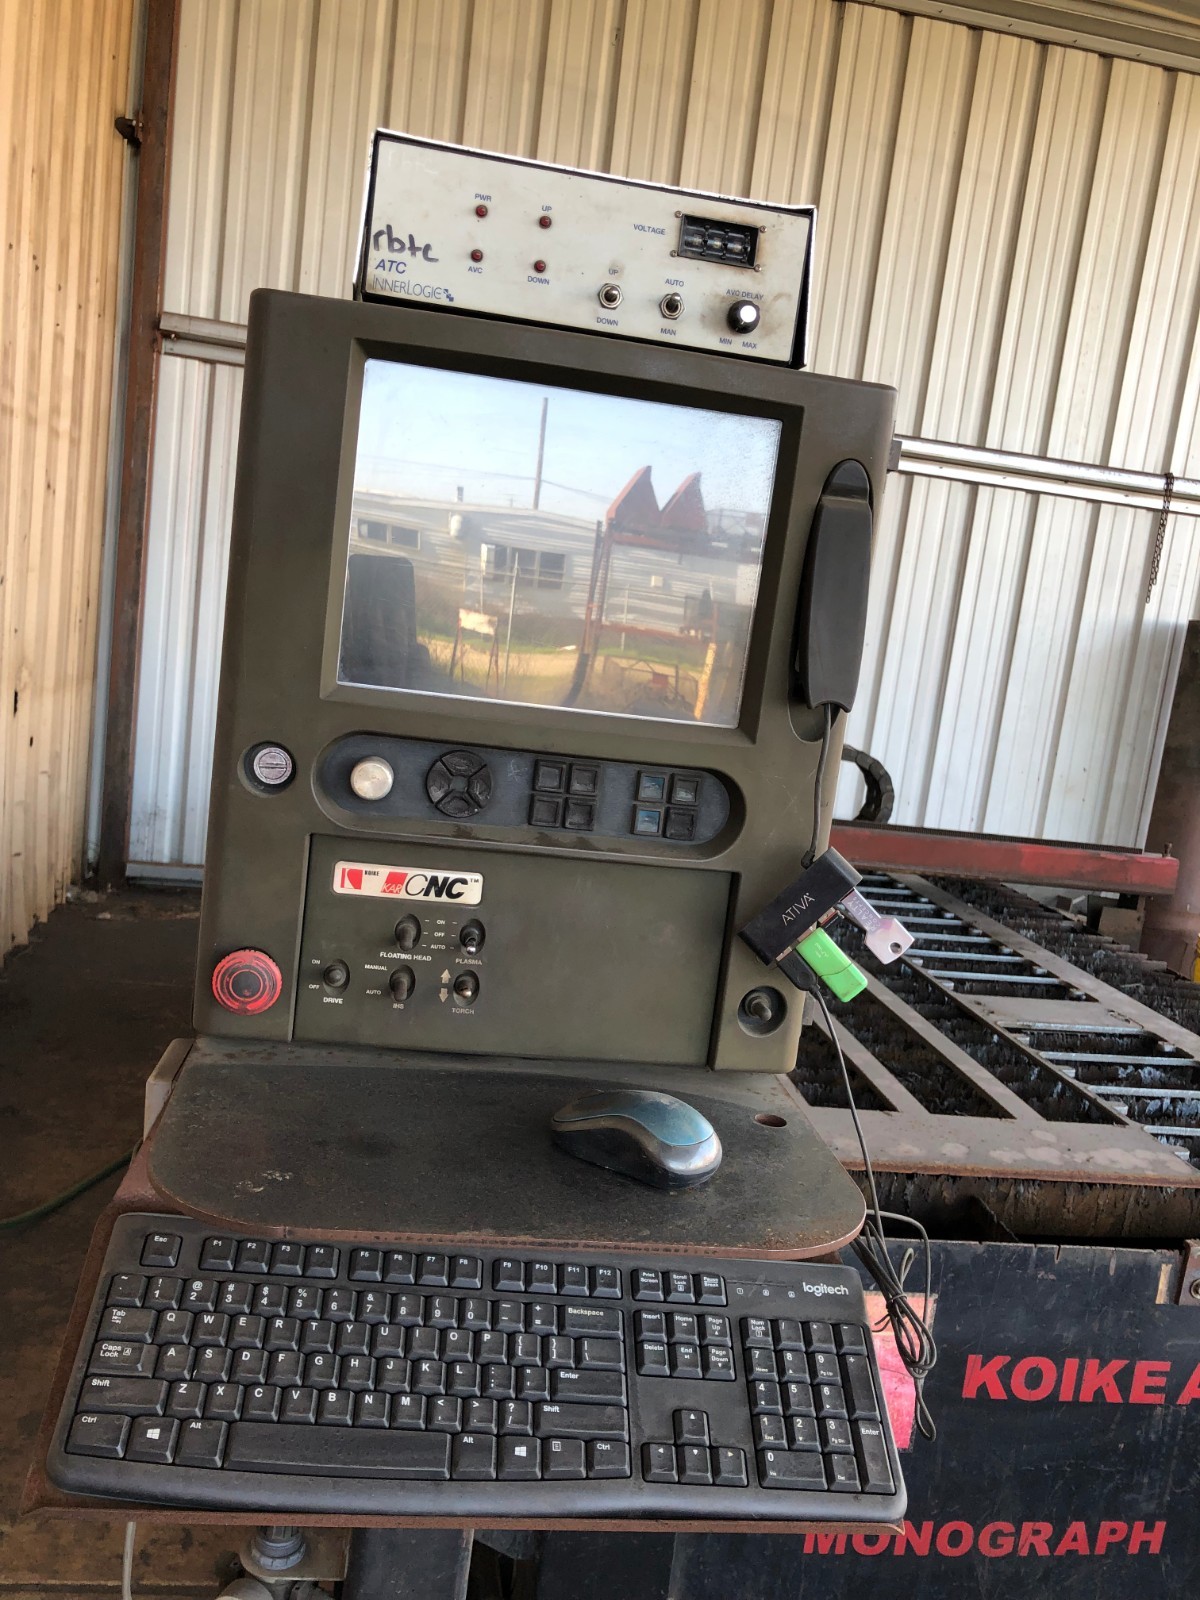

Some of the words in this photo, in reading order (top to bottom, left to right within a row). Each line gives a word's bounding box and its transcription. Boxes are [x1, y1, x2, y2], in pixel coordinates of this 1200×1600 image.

[475, 193, 492, 202] PWR
[633, 224, 666, 235] VOLTAGE
[375, 259, 407, 274] ATC
[468, 266, 483, 274] AVC
[527, 276, 550, 285] DOWN
[665, 278, 684, 287] AUTO
[726, 289, 740, 297] AVC
[742, 291, 764, 300] DELAY
[596, 317, 618, 326] DOWN
[661, 328, 676, 336] MAN
[720, 337, 732, 345] MIN
[742, 341, 757, 349] MAX
[405, 874, 468, 899] CNC
[781, 894, 815, 926] ATIVA
[847, 899, 877, 931] REALTY
[380, 952, 412, 960] FLOATING
[154, 1235, 167, 1243] Esc
[154, 1289, 160, 1298] 1
[803, 1282, 849, 1297] logitech
[189, 1291, 196, 1300] 2
[225, 1294, 232, 1303] 3
[260, 1297, 268, 1305] 4
[295, 1299, 302, 1308] 5
[331, 1301, 337, 1311] 6
[366, 1304, 372, 1313] 7
[112, 1309, 126, 1317] Tab
[400, 1307, 406, 1315] 8
[434, 1309, 440, 1318] 9
[467, 1311, 474, 1320] 0
[568, 1307, 604, 1317] Backspace
[166, 1312, 176, 1322] Q
[203, 1315, 214, 1324] W
[239, 1317, 247, 1326] E
[275, 1319, 283, 1328] R
[310, 1322, 318, 1331] T
[346, 1324, 353, 1333] Y
[381, 1327, 389, 1336] U
[450, 1332, 458, 1341] O
[484, 1334, 491, 1342] P
[102, 1343, 121, 1351] Caps
[100, 1350, 119, 1358] Lock
[167, 1349, 176, 1357] A
[204, 1349, 212, 1358] S
[242, 1352, 250, 1360] D
[786, 1353, 793, 1361] 8
[278, 1354, 285, 1362] F
[314, 1356, 323, 1365] G
[818, 1355, 824, 1363] 9
[350, 1359, 359, 1367] H
[387, 1361, 393, 1369] J
[422, 1363, 430, 1372] K
[456, 1365, 463, 1374] L
[560, 1371, 579, 1380] Enter
[962, 1354, 1171, 1405] KOIKE
[91, 1379, 110, 1387] Shift
[759, 1383, 765, 1391] 4
[179, 1384, 187, 1393] Z
[216, 1386, 224, 1396] X
[254, 1388, 263, 1398] C
[791, 1385, 797, 1393] 5
[823, 1387, 830, 1395] 6
[292, 1390, 300, 1399] V
[328, 1393, 336, 1402] B
[365, 1395, 373, 1404] N
[401, 1397, 410, 1406] M
[508, 1403, 515, 1413] ?
[543, 1404, 559, 1413] Shift
[762, 1417, 768, 1425] 1
[797, 1419, 803, 1427] 2
[829, 1421, 836, 1429] 3
[861, 1428, 880, 1436] Enter
[596, 1443, 610, 1451] Ctrl
[767, 1452, 774, 1461] 0
[803, 1521, 1167, 1558] MONOGRAPH
